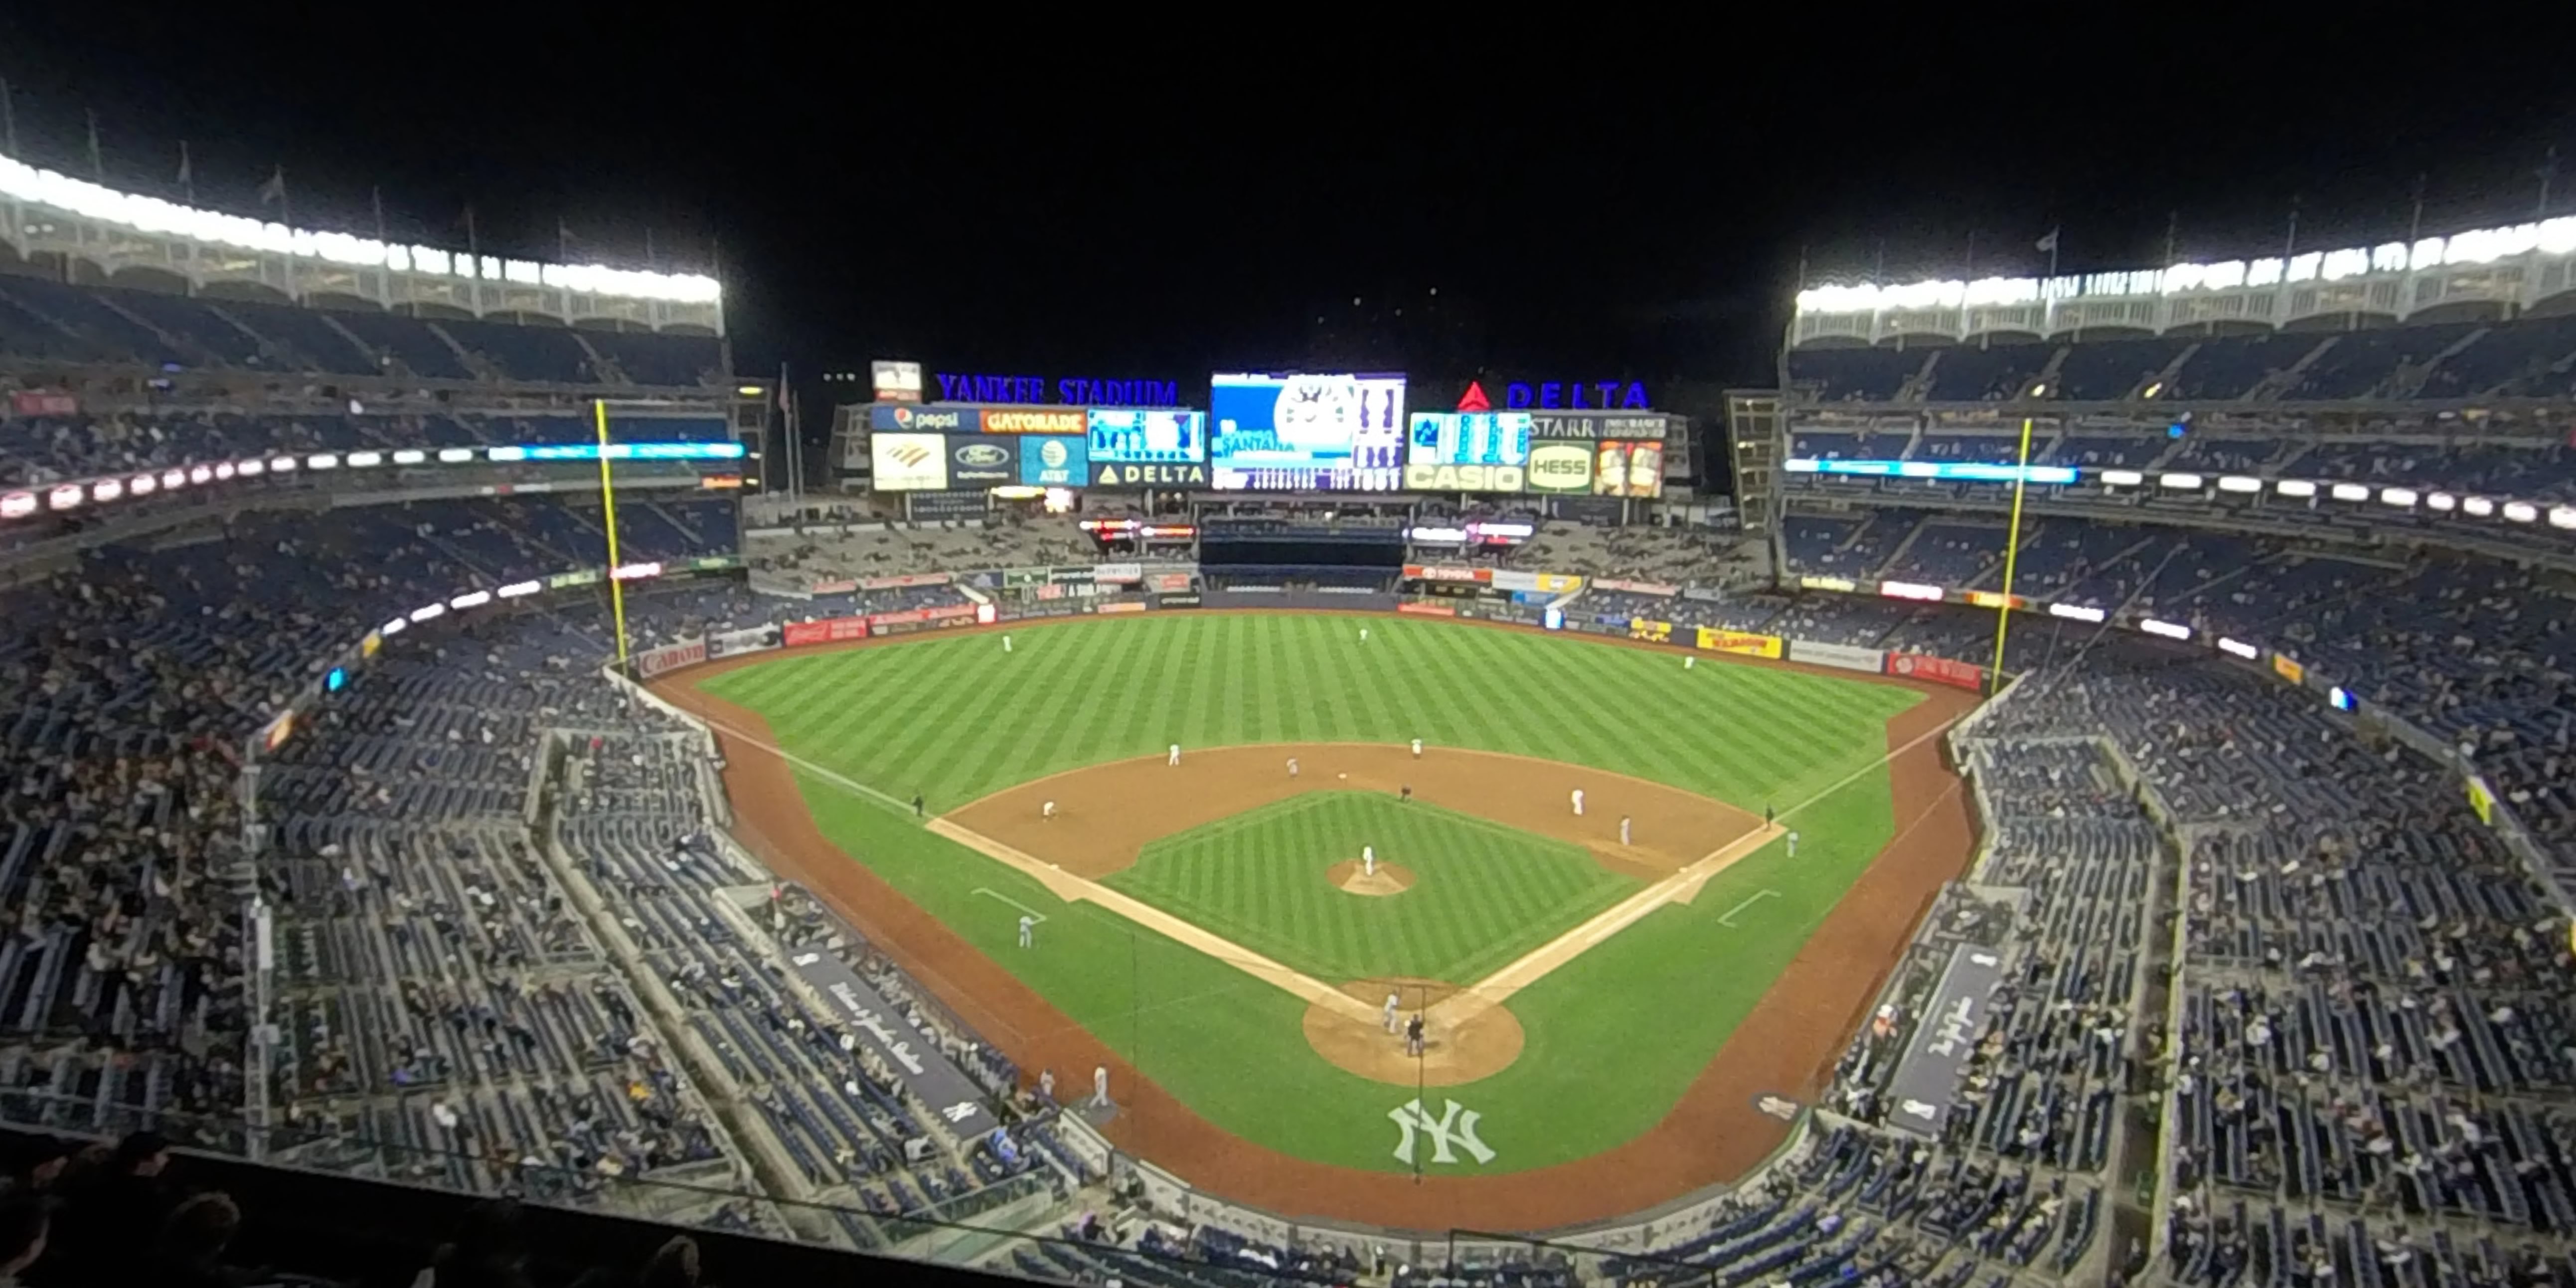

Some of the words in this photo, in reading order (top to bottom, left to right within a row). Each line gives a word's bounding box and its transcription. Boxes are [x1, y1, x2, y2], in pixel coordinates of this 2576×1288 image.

[936, 373, 1044, 403] YANKEE
[1058, 378, 1178, 406] STADIUM
[1507, 381, 1651, 410] DELTA
[916, 412, 959, 429] pepsi
[986, 413, 1083, 432] GATORADE
[1530, 418, 1596, 438] STARR
[1125, 465, 1204, 483] DELTA
[1406, 465, 1523, 489] CASIO
[1533, 459, 1587, 475] HESS
[1387, 1097, 1496, 1165] NY
